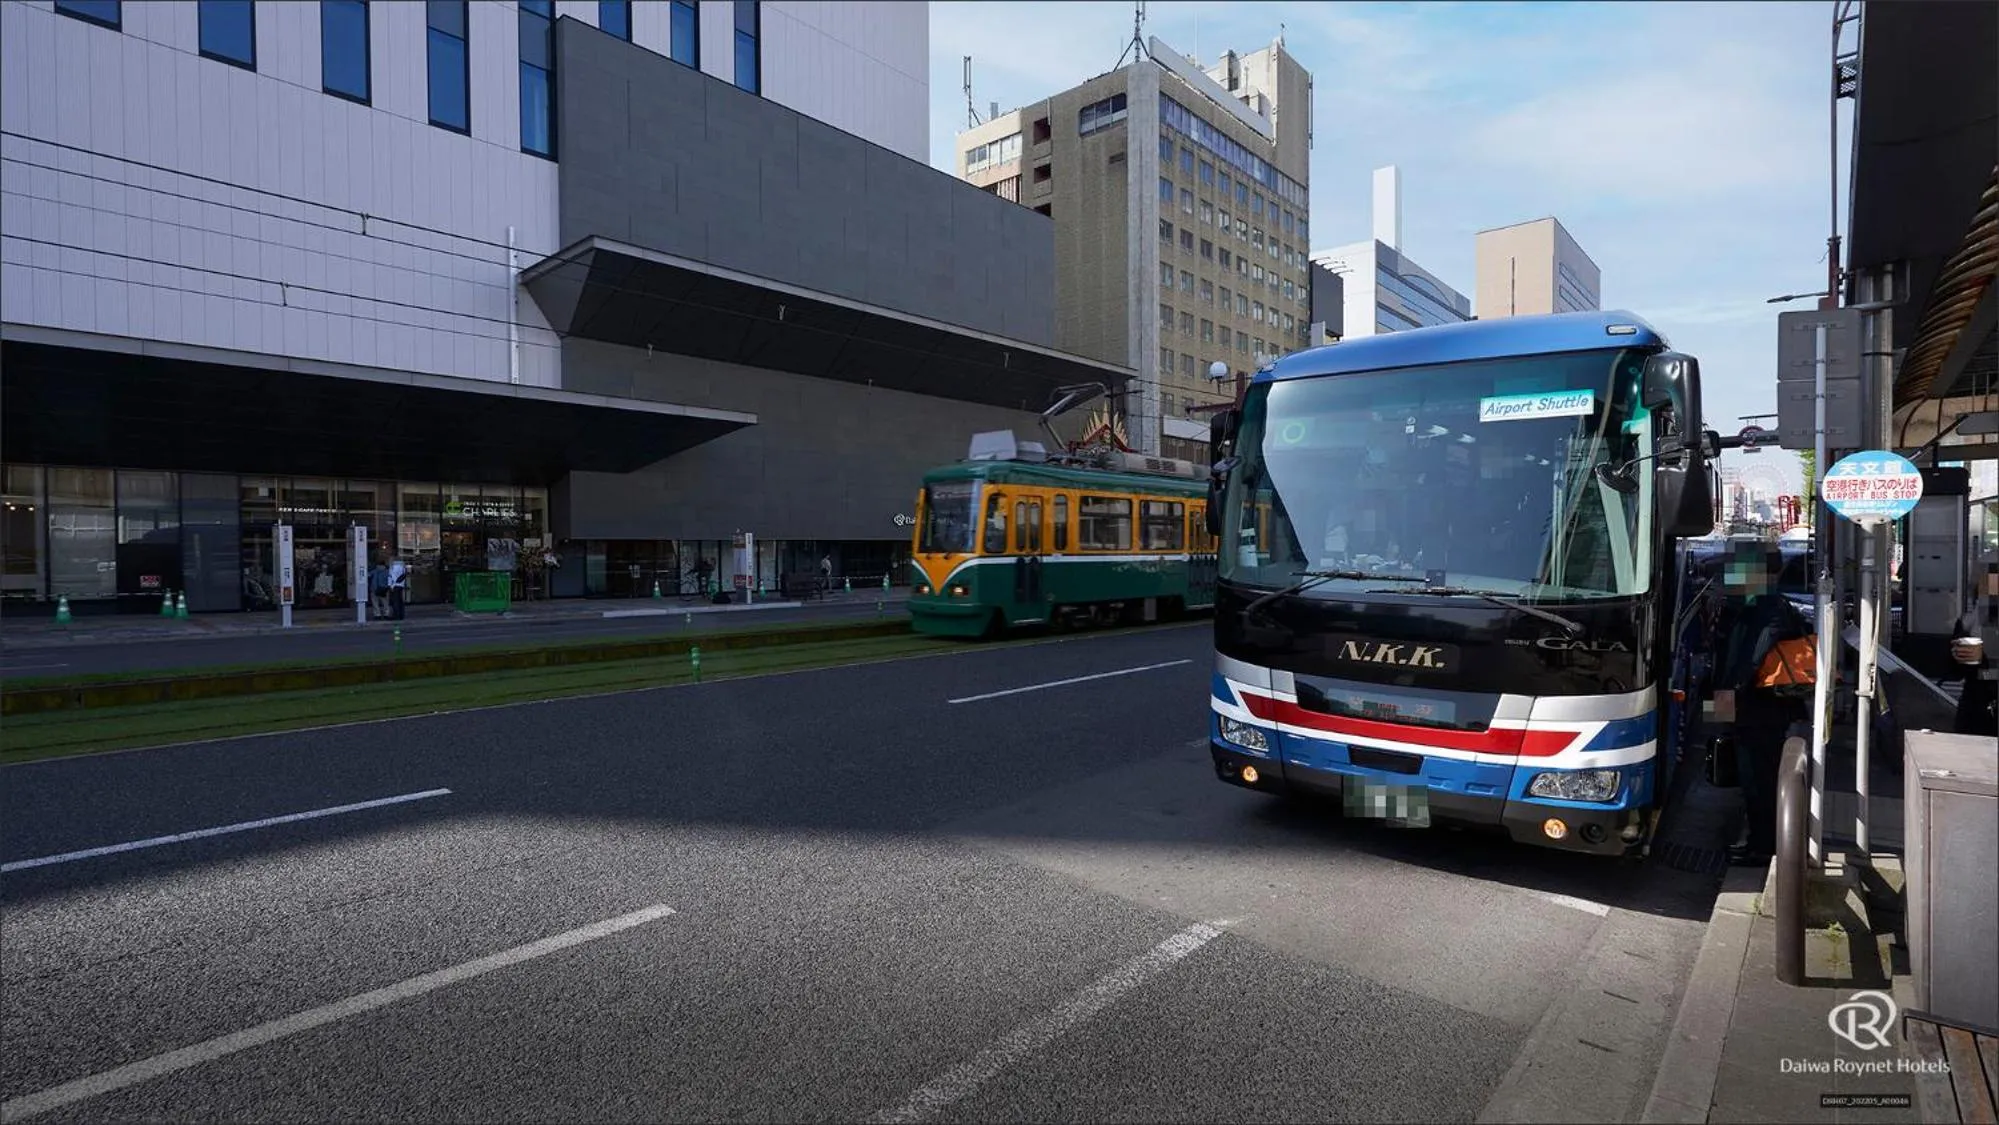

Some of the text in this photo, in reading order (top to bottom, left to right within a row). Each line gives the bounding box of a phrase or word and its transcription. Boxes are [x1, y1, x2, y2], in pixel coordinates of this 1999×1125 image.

[1485, 395, 1589, 416] Airport Shuttle
[1826, 490, 1917, 500] AIRPORT BUS STOP
[1536, 637, 1629, 652] GALA
[1337, 640, 1446, 669] N.K.K.
